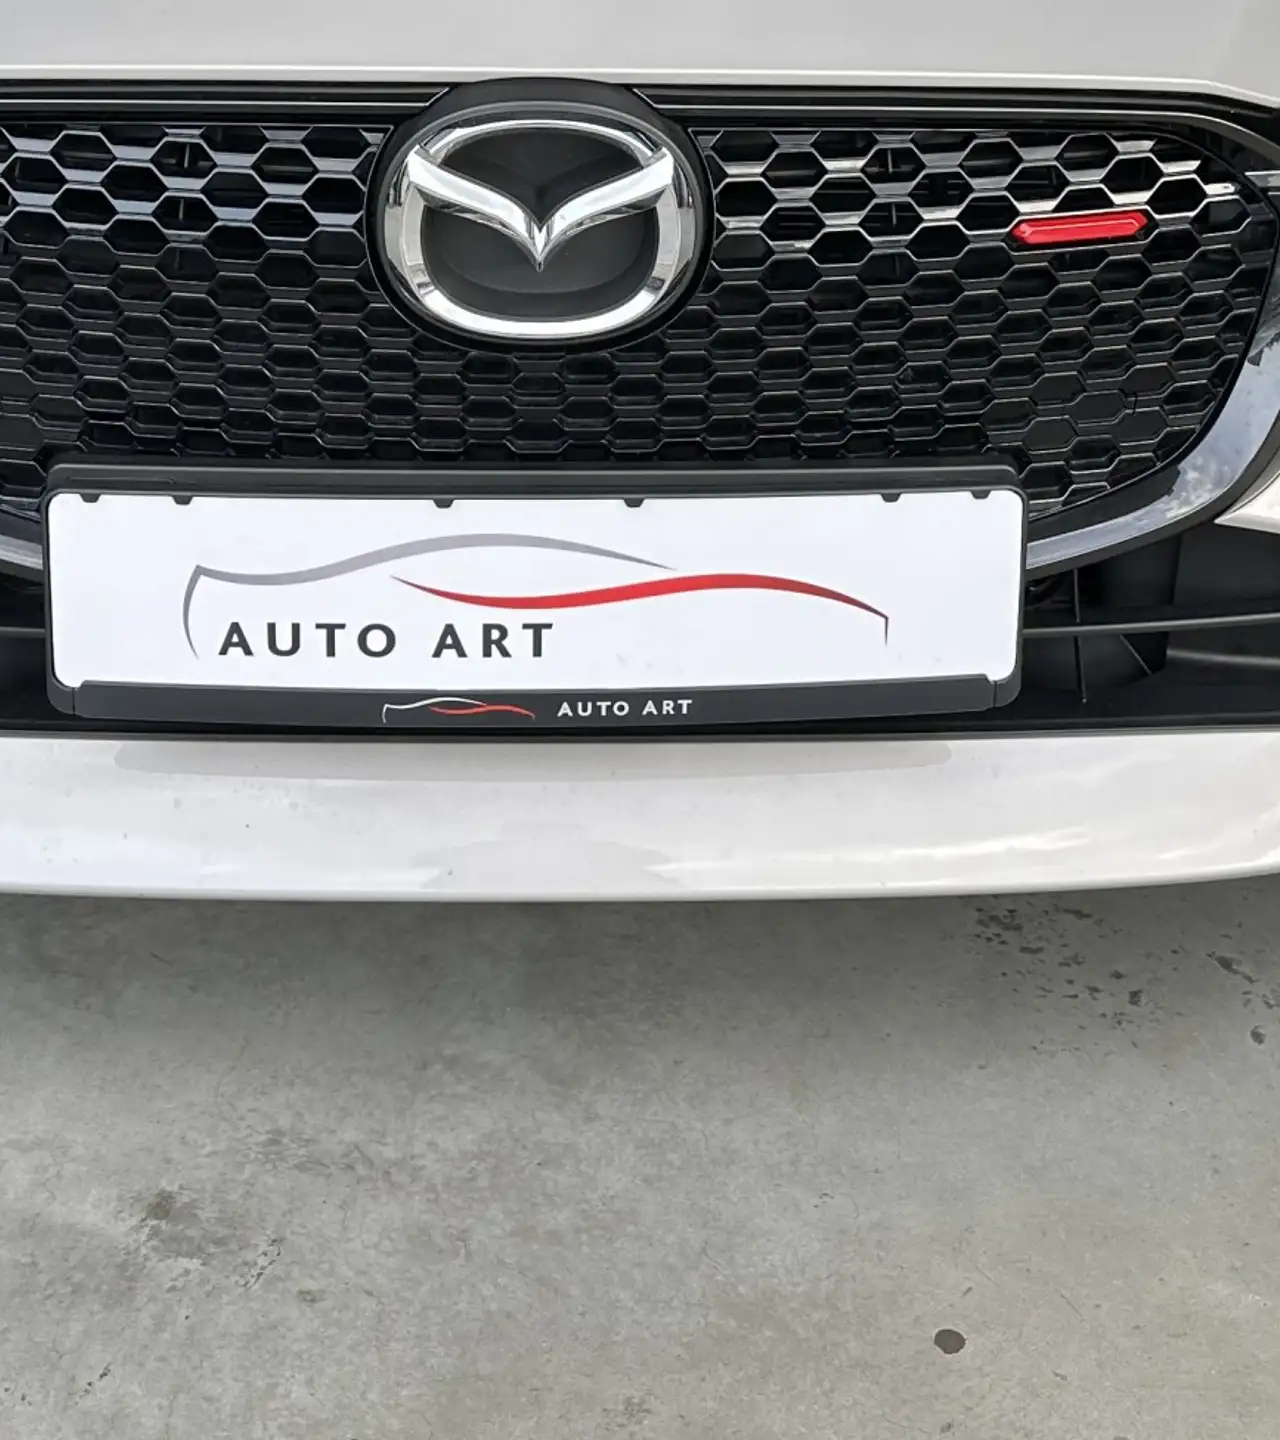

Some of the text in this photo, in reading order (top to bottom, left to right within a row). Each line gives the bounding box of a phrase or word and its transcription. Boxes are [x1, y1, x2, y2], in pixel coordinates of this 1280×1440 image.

[219, 622, 553, 658] AUTO ART
[557, 699, 693, 717] AUTO ART
